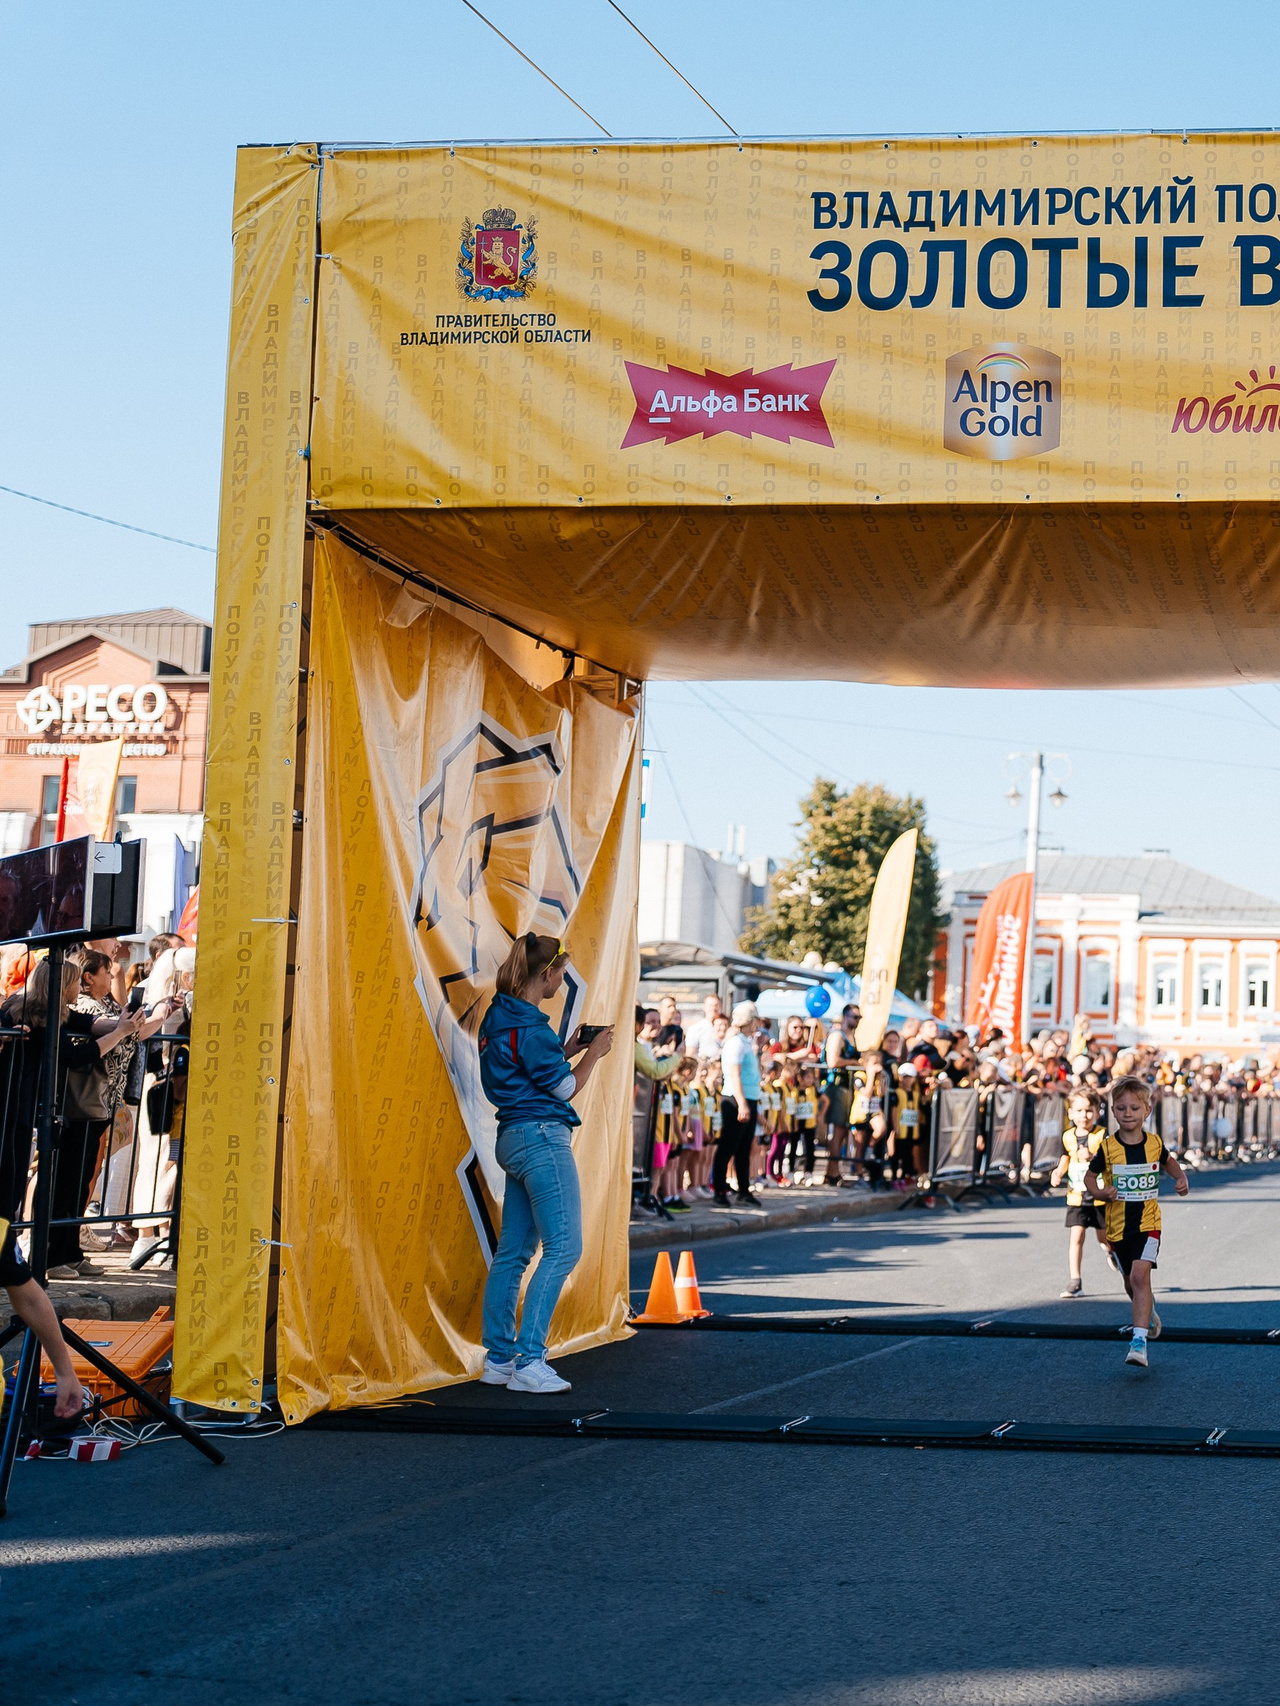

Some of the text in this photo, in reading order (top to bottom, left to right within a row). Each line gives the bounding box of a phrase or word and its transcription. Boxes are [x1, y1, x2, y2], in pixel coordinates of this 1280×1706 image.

[810, 175, 1196, 232] ВЛАДИМИРСКИЙ
[806, 235, 1205, 312] ЗОЛОТЫЕ
[400, 328, 591, 347] ВЛАДИМИРСКОЙ ОБЛАСТИ
[435, 313, 557, 329] ПРАВИТЕЛЬСТВО
[649, 389, 810, 418] Альфа Банк
[952, 369, 1053, 413] Alpen
[959, 404, 1042, 437] Gold
[62, 684, 168, 722] РЕСО
[1117, 1174, 1156, 1190] 5089
